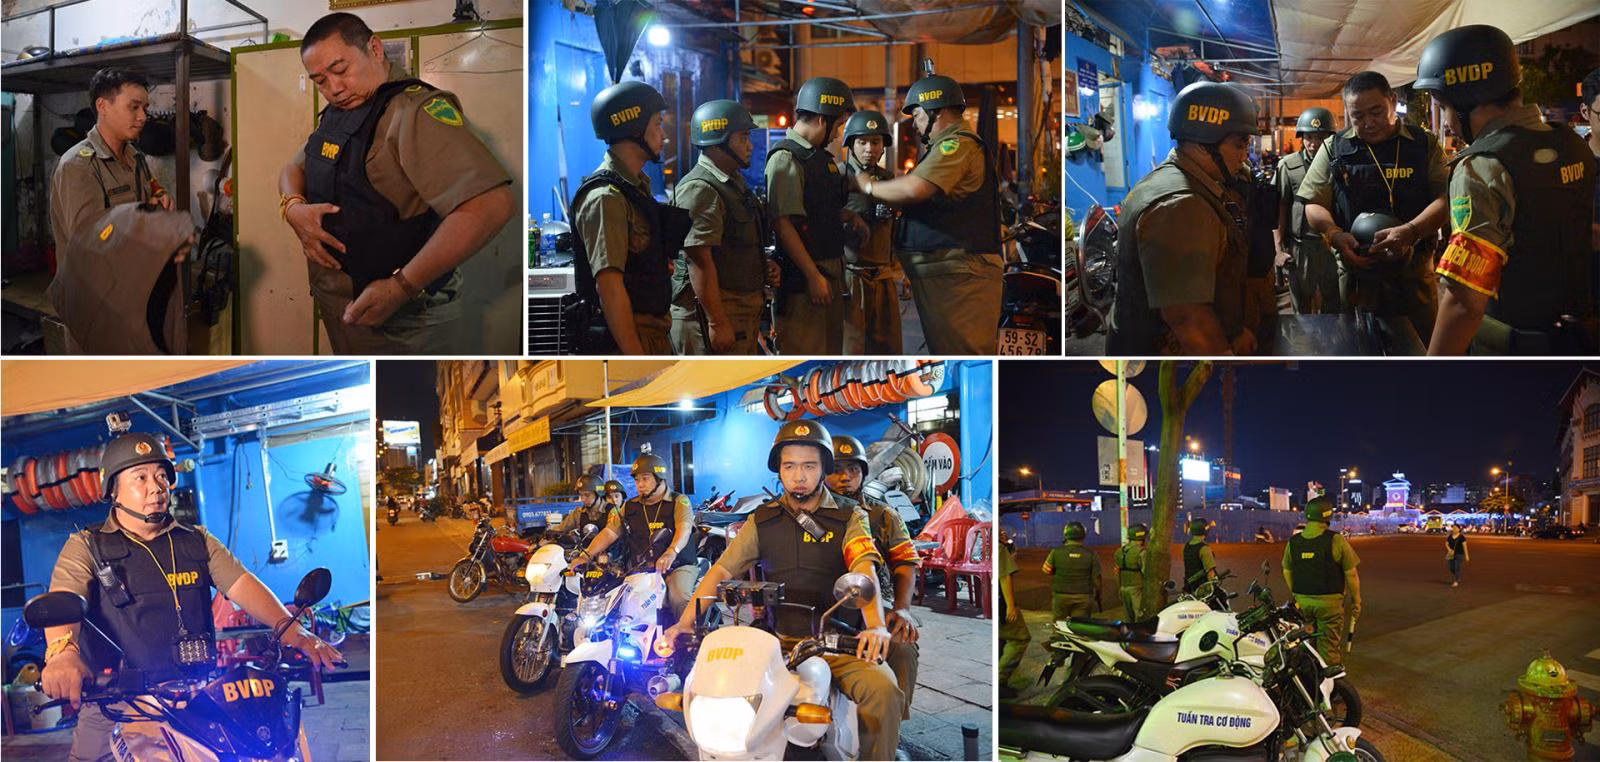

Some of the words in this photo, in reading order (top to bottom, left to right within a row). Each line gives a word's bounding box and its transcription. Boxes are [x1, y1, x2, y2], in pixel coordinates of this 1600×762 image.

[1445, 62, 1493, 86] BVDP
[820, 95, 845, 107] BVDP
[919, 90, 943, 102] BVDP
[610, 106, 641, 127] BVDP
[1188, 105, 1230, 125] BVDP
[701, 118, 729, 133] BVDP
[1385, 168, 1414, 179] BVDP
[1560, 162, 1585, 184] BVDP
[938, 455, 953, 470] VÀO
[803, 531, 834, 543] BP
[707, 647, 744, 663] BVDP
[222, 679, 275, 703] BVDP
[1199, 714, 1214, 726] TRA
[1216, 715, 1228, 727] CƠ
[1229, 714, 1251, 730] ĐỘNG
